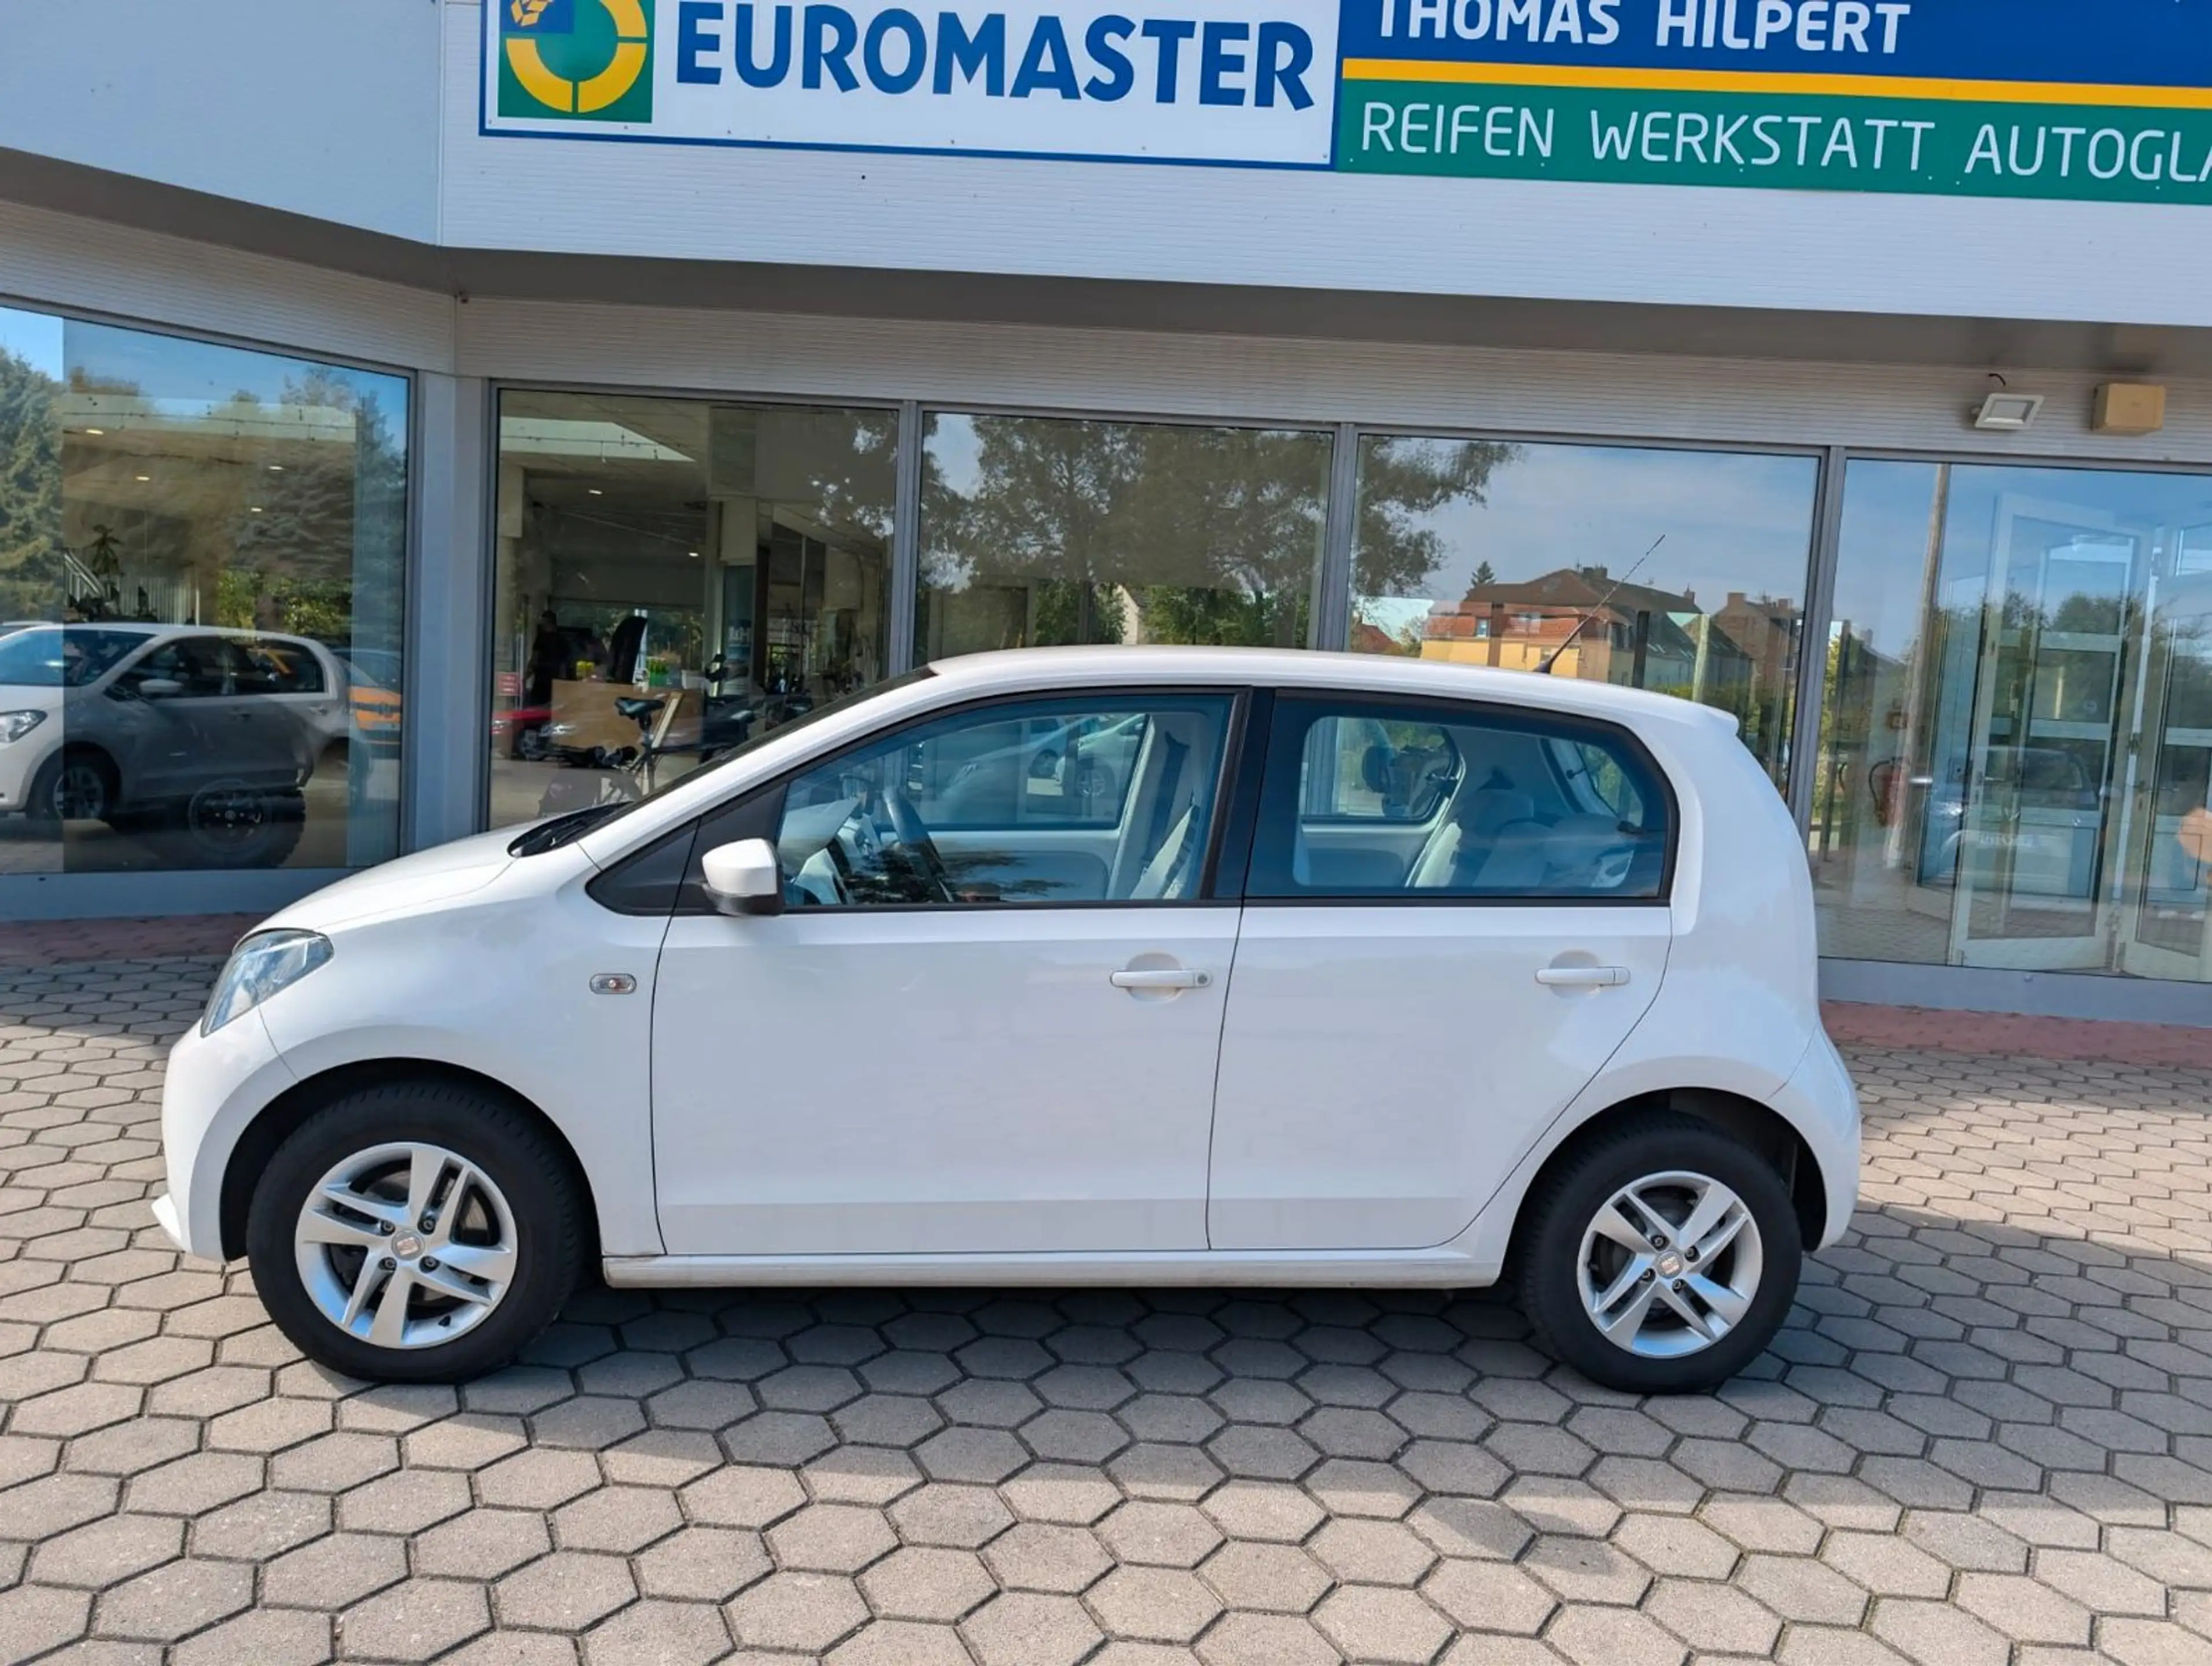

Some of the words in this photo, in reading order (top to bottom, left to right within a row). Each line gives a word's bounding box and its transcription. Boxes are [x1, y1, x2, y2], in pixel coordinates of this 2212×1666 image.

[676, 0, 1315, 111] EUROMASTER
[1656, 0, 1910, 53] HILPERT
[1362, 102, 1554, 157] REIFEN
[1591, 110, 1935, 171] WERKSTATT
